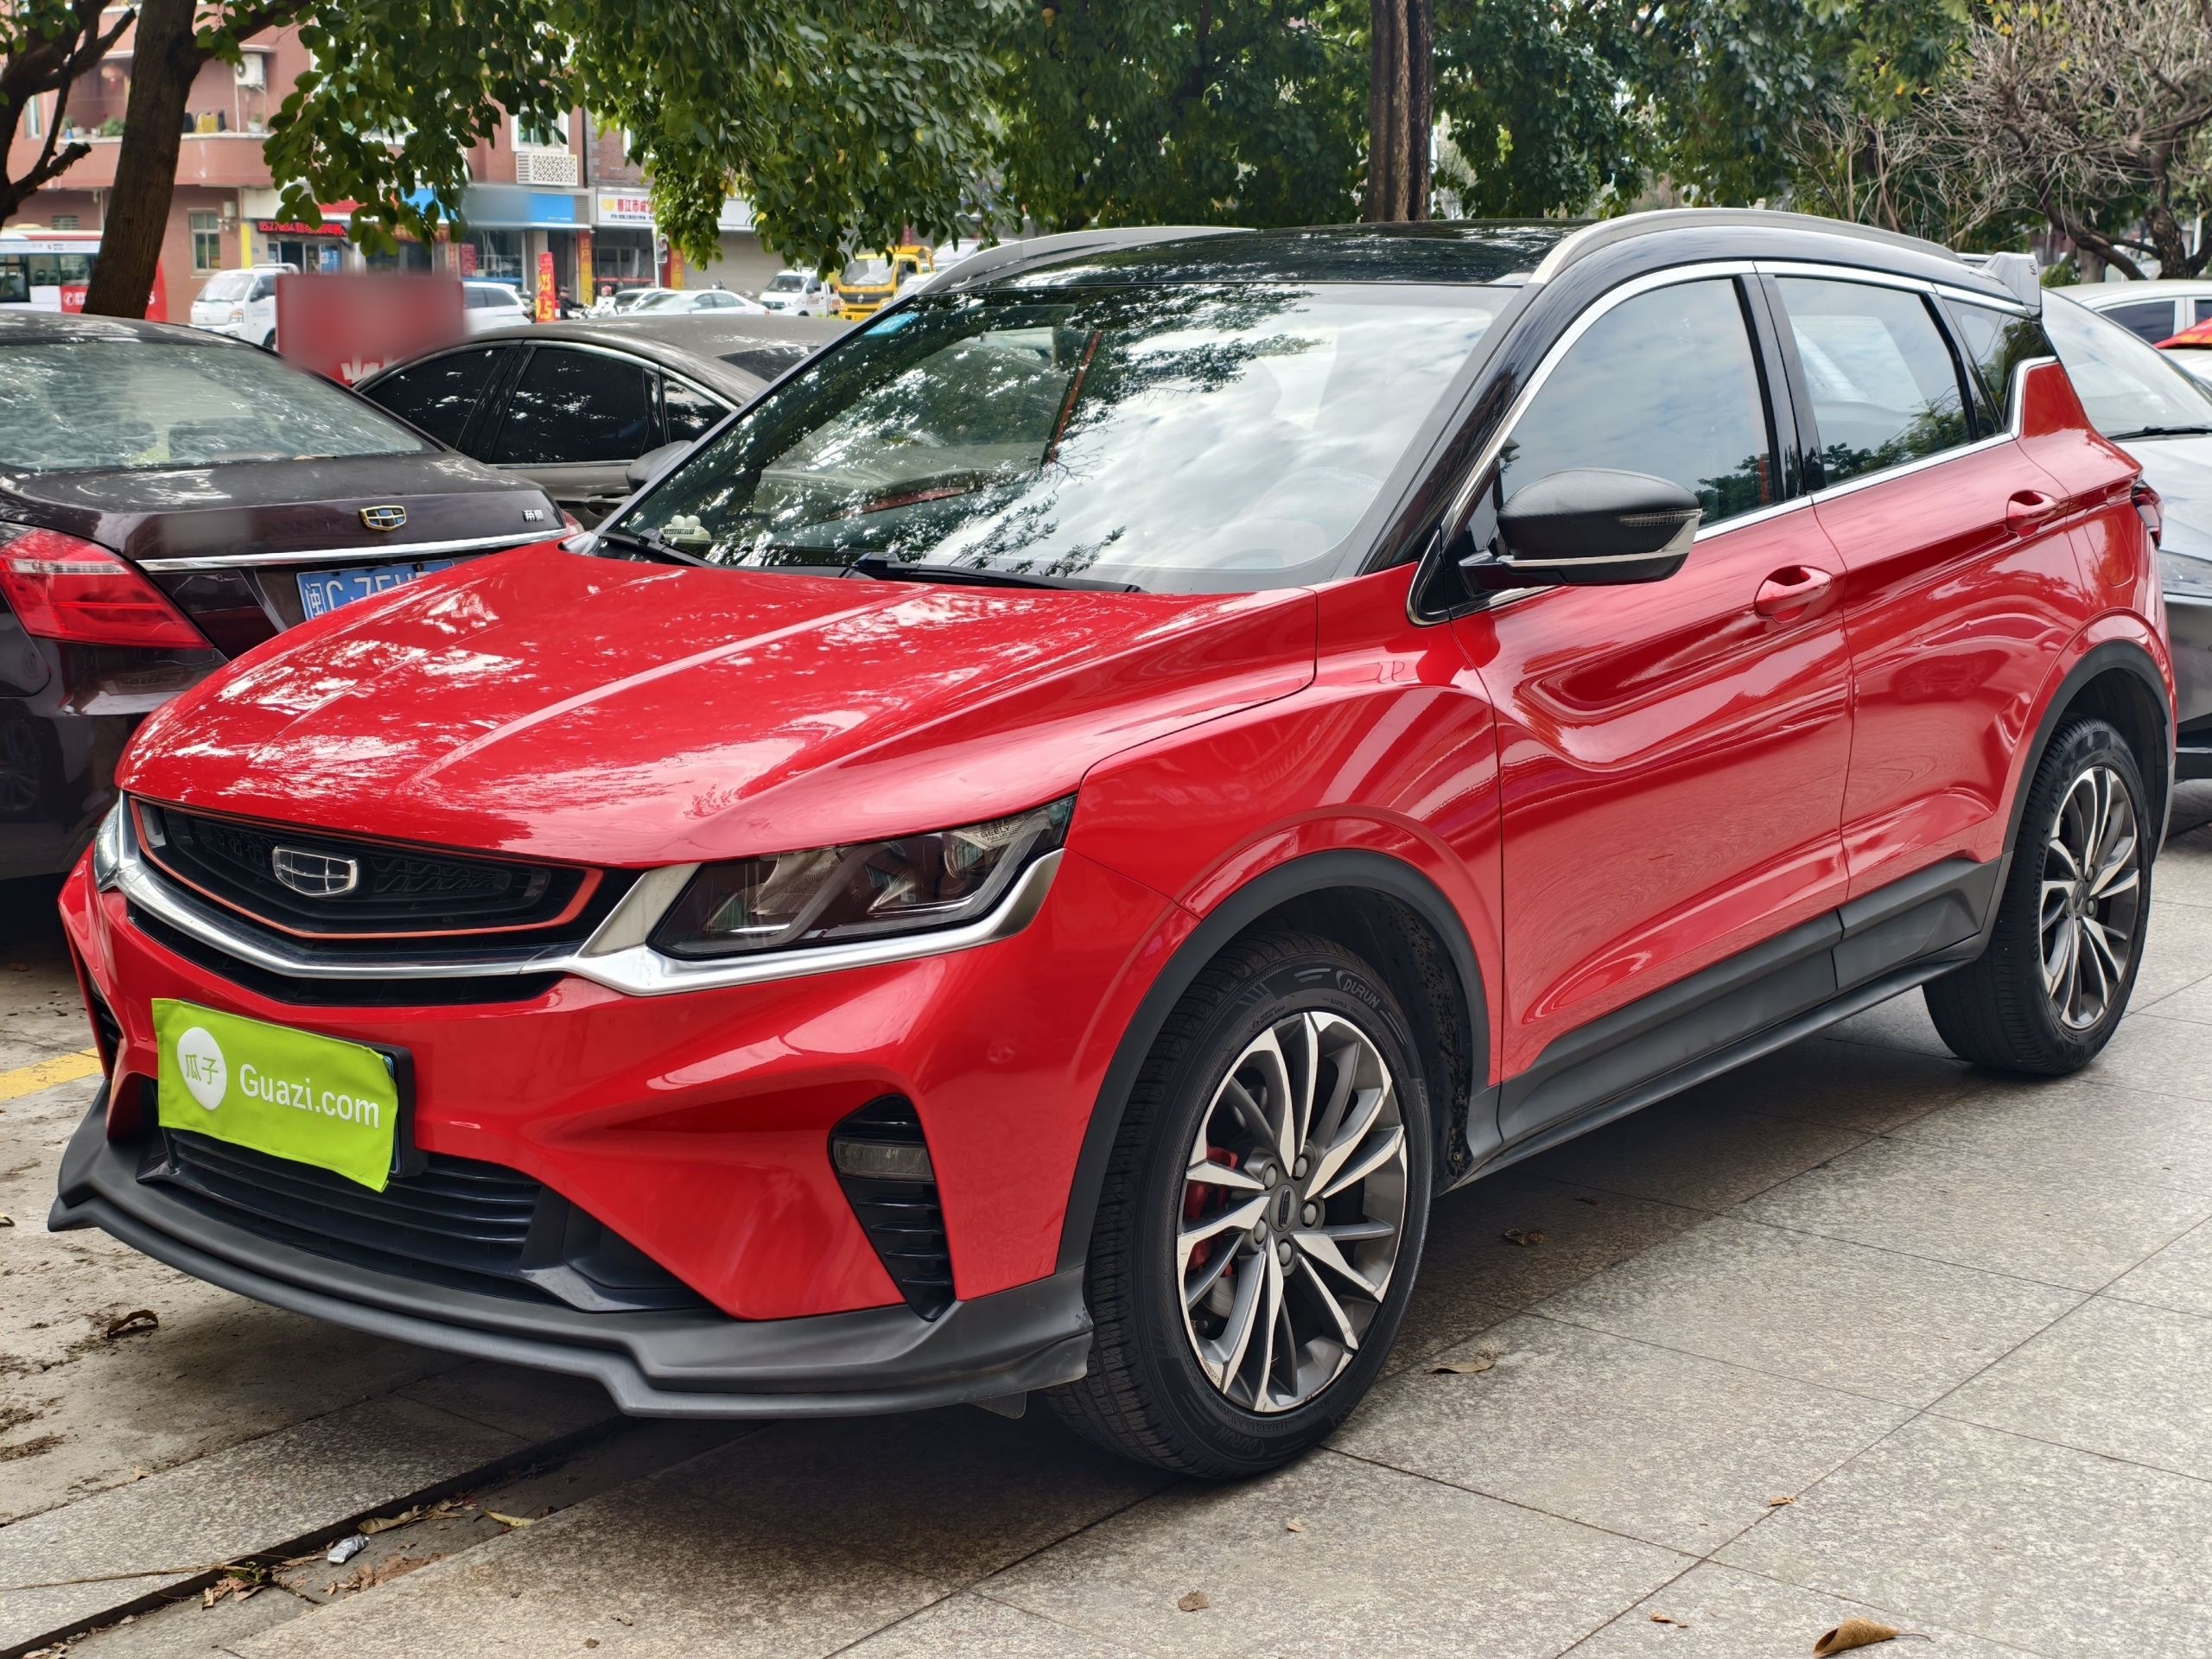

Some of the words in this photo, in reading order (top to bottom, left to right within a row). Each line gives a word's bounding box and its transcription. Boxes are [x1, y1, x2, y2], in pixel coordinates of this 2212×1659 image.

[980, 825, 1011, 838] GEELY
[1344, 978, 1382, 1009] DURUN
[184, 1053, 219, 1085] 瓜子
[239, 1063, 380, 1129] Guazi.com
